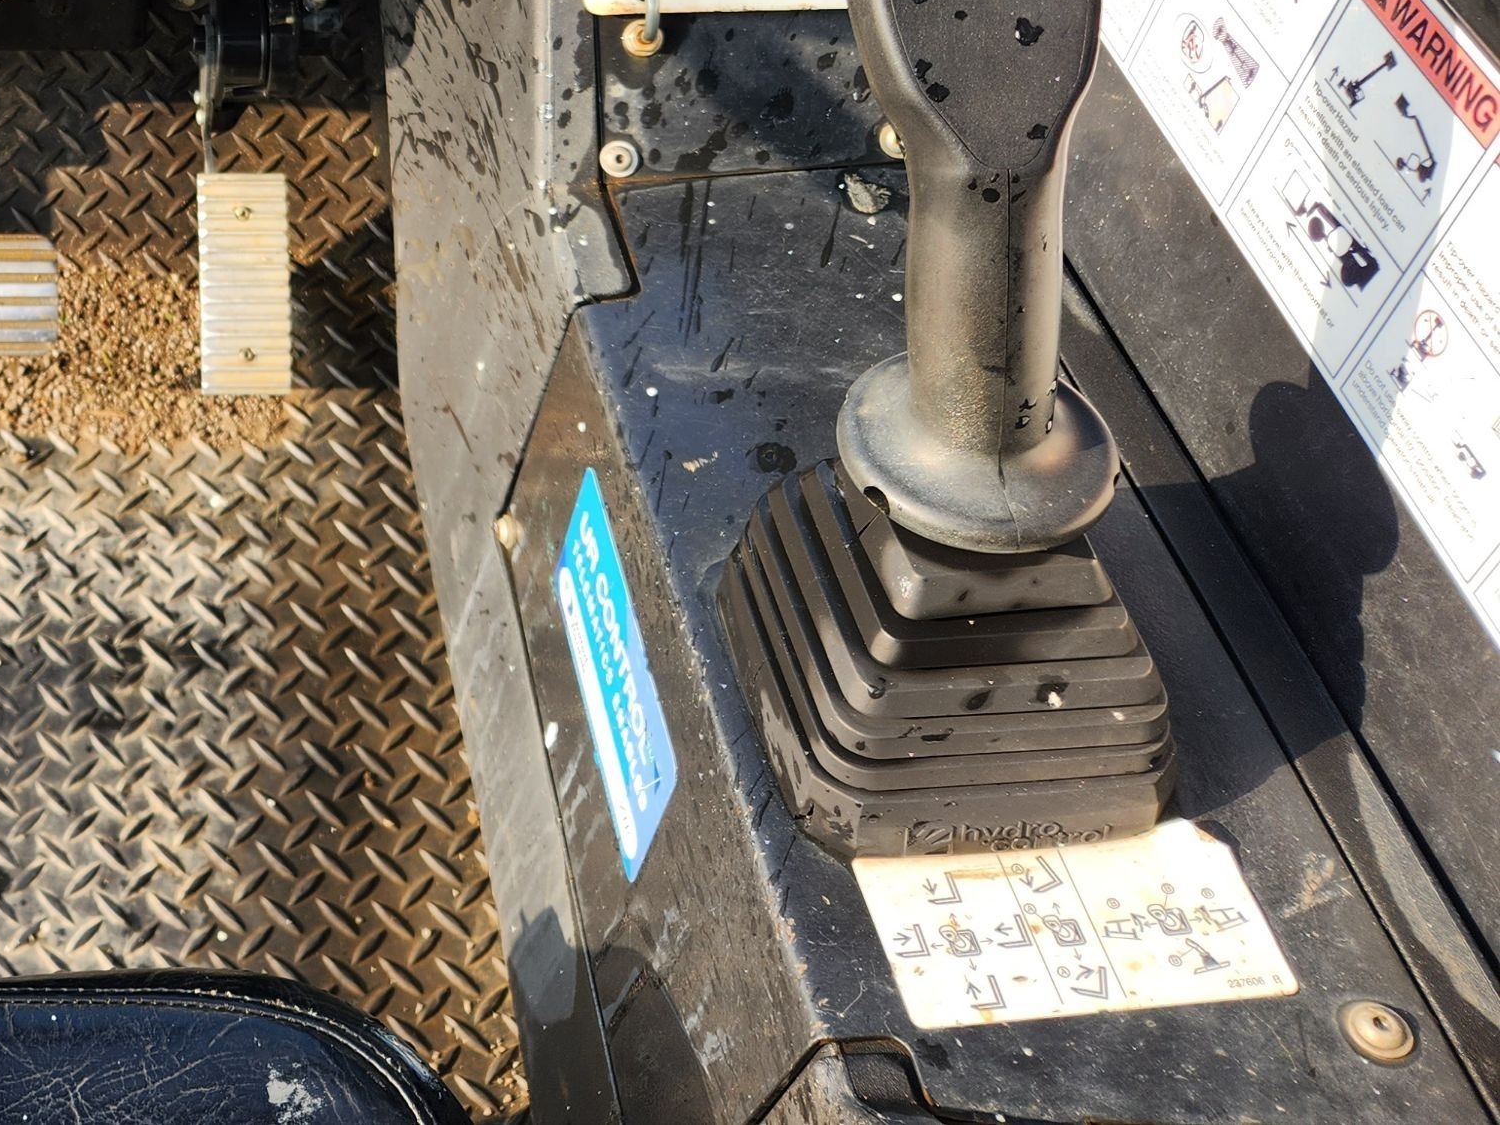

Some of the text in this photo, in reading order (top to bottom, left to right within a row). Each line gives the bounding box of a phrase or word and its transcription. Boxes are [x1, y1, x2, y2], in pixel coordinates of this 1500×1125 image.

[1311, 82, 1358, 141] Tip-over Hazard
[1321, 137, 1339, 159] death
[1346, 171, 1369, 201] serious
[1367, 201, 1392, 230] injury.
[1331, 133, 1344, 148] with
[1351, 160, 1379, 194] elevated
[1378, 195, 1392, 213] load
[1391, 215, 1405, 230] can
[572, 539, 613, 685] TELEMATICS
[580, 510, 599, 573] UR
[596, 572, 647, 765] CONTROL
[962, 819, 1062, 845] hydro
